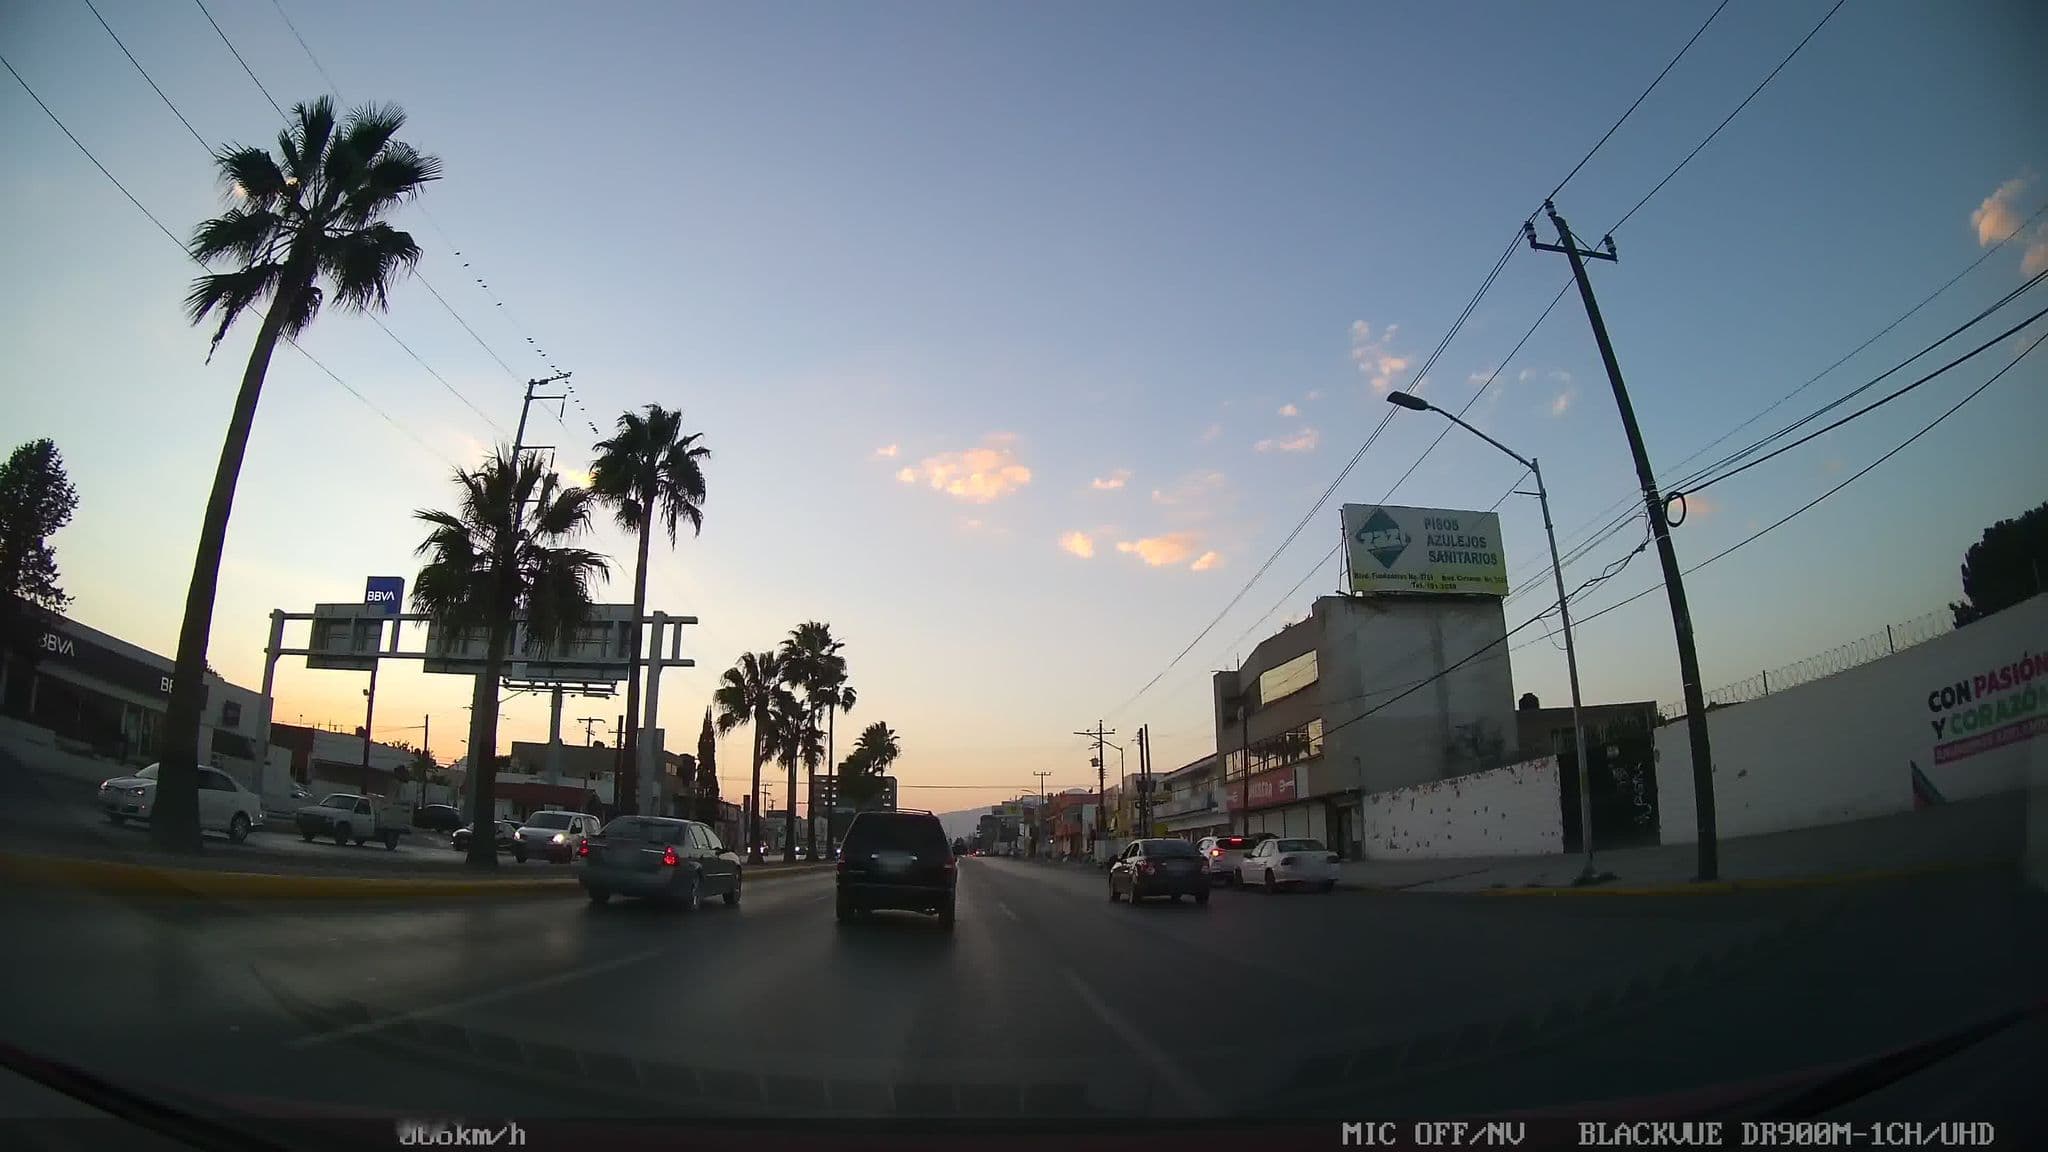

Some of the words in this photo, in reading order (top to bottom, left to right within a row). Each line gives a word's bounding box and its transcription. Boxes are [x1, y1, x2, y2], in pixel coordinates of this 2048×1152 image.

[1424, 516, 1459, 531] PISOS
[1426, 534, 1487, 549] AZULEJOS
[1428, 551, 1498, 566] SANITARIOS
[367, 591, 395, 601] BBVA
[1928, 680, 1971, 712] CON
[1973, 651, 2048, 699] PASIÓN
[1931, 717, 1946, 740] Y
